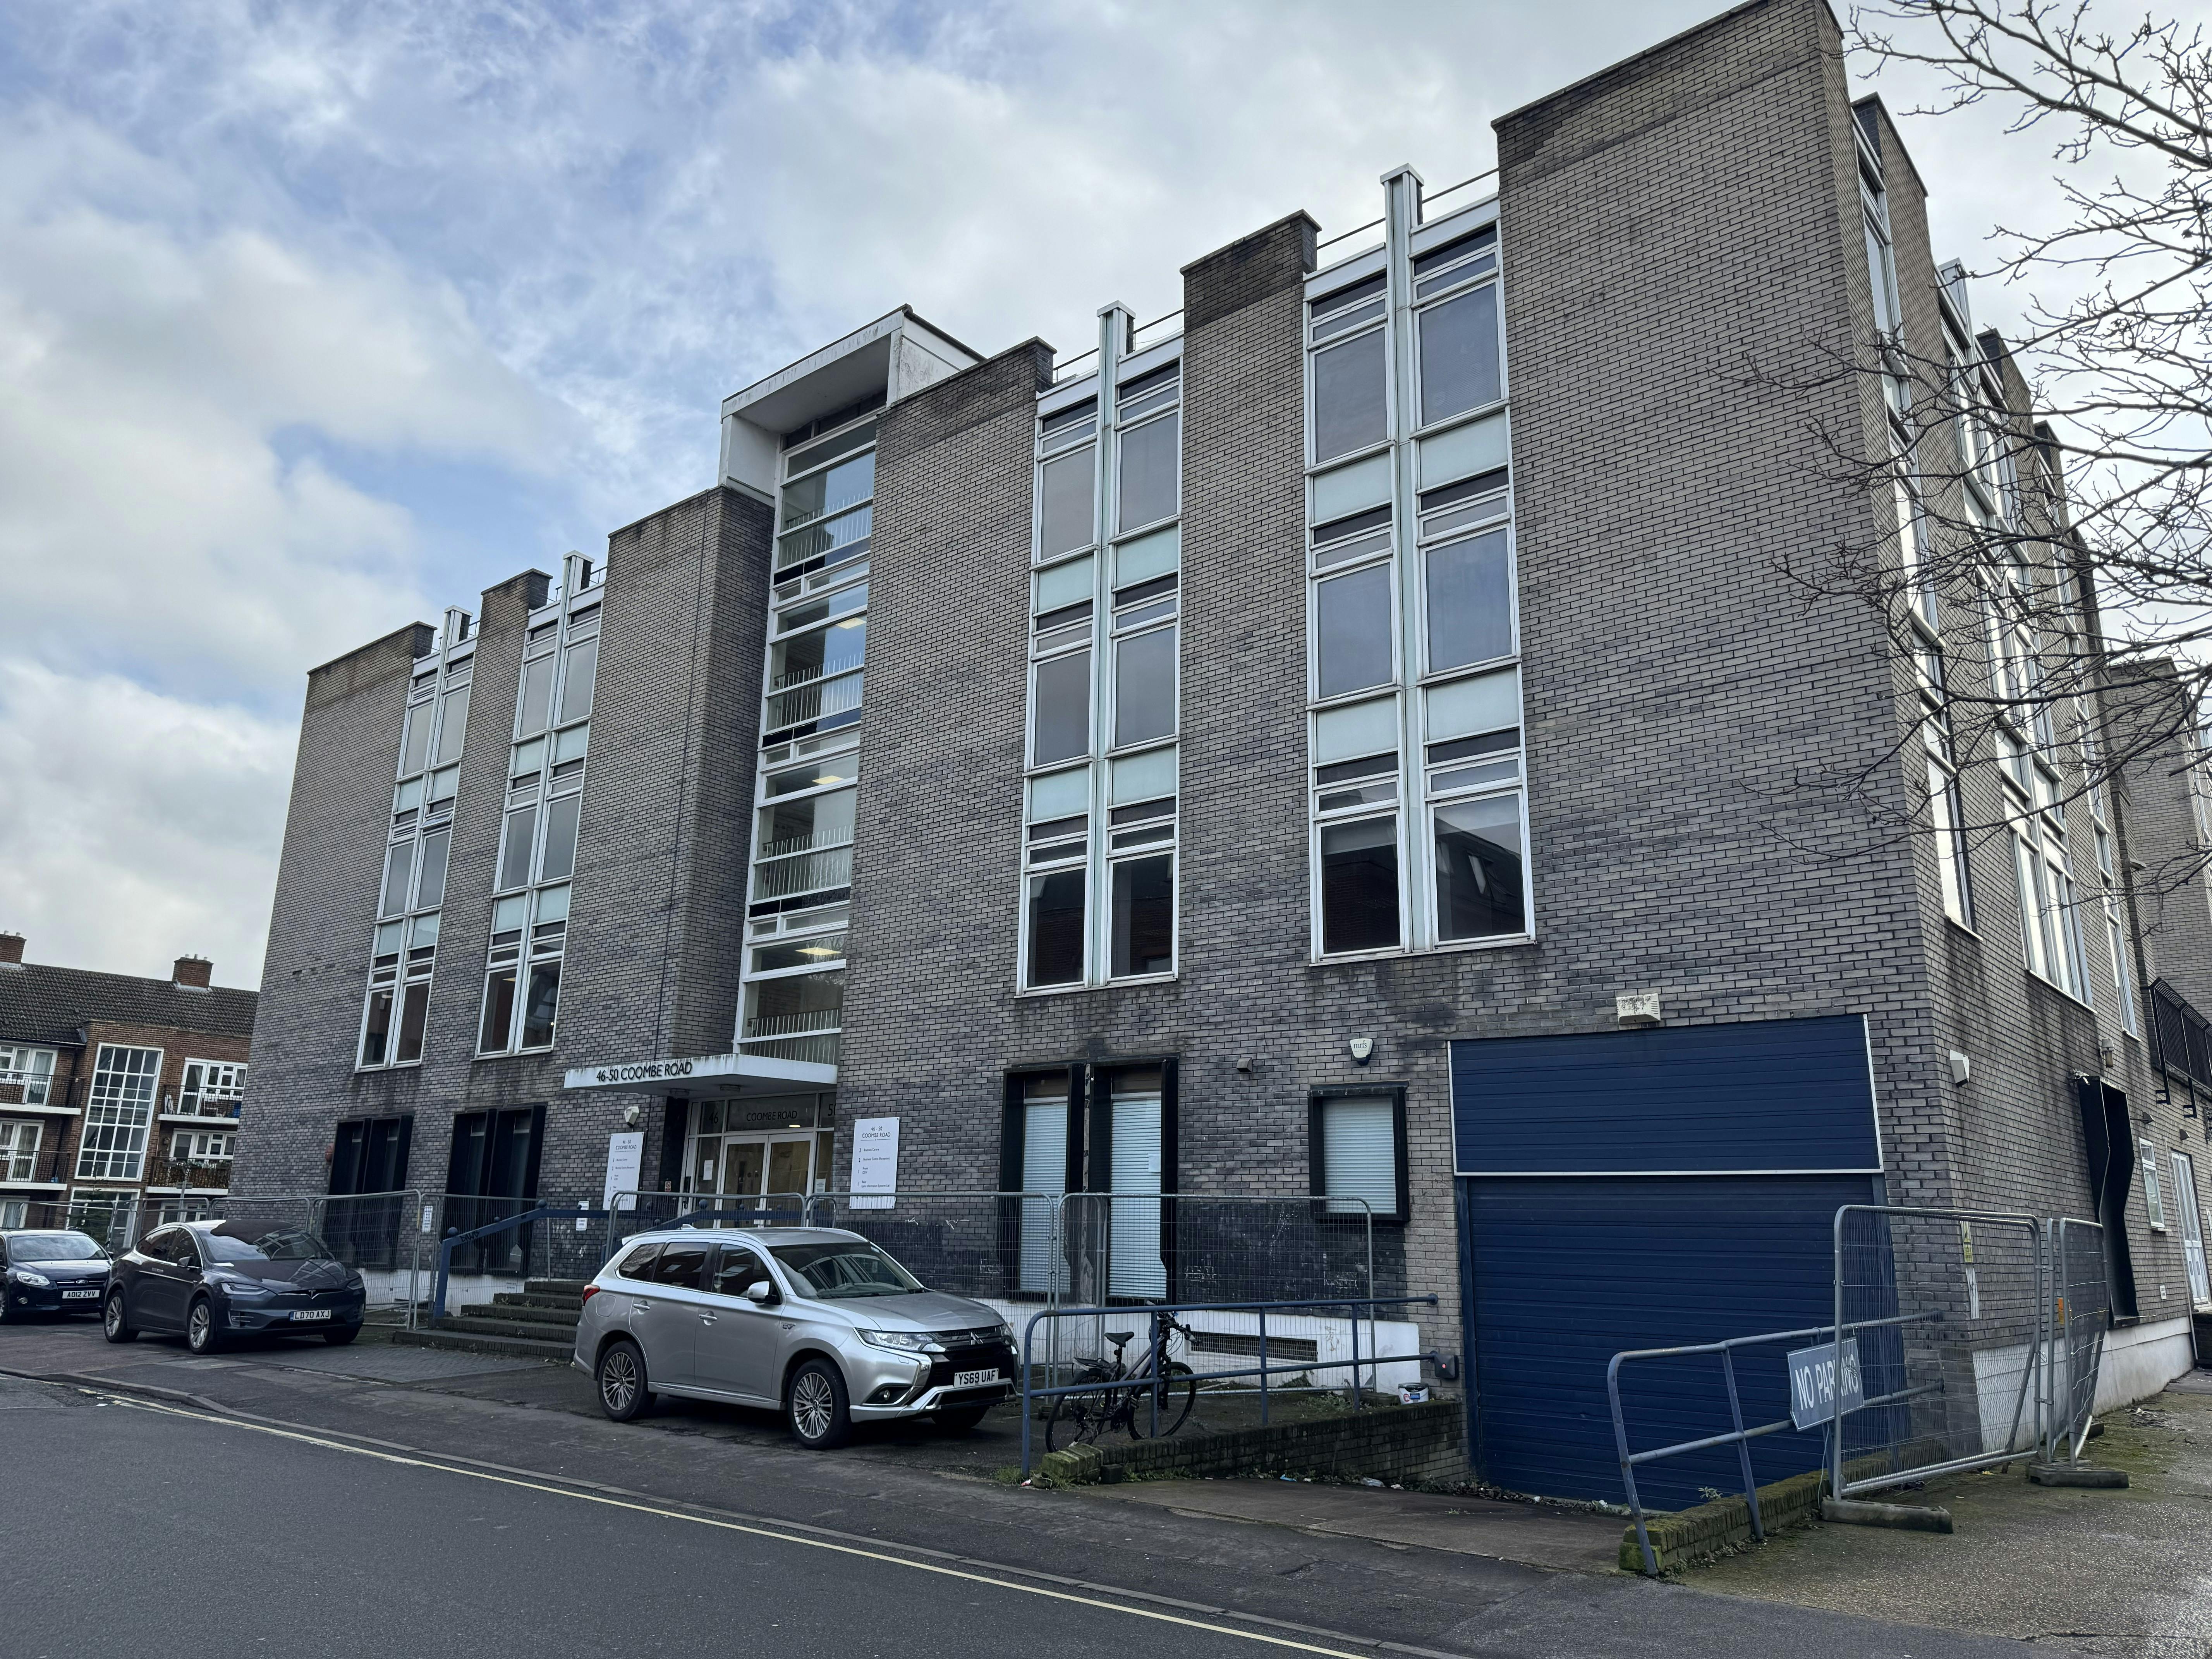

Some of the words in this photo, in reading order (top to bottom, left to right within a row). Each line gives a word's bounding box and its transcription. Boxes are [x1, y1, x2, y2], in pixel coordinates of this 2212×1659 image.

[596, 1068, 618, 1082] 46-50
[621, 1064, 663, 1080] COOMBE
[665, 1062, 693, 1076] ROAD
[709, 1112, 718, 1124] 46
[746, 1111, 776, 1121] COOMBE
[778, 1111, 797, 1120] ROAD
[958, 1372, 979, 1385] YS69
[981, 1370, 996, 1382] UAF
[1795, 1365, 1814, 1410] NO
